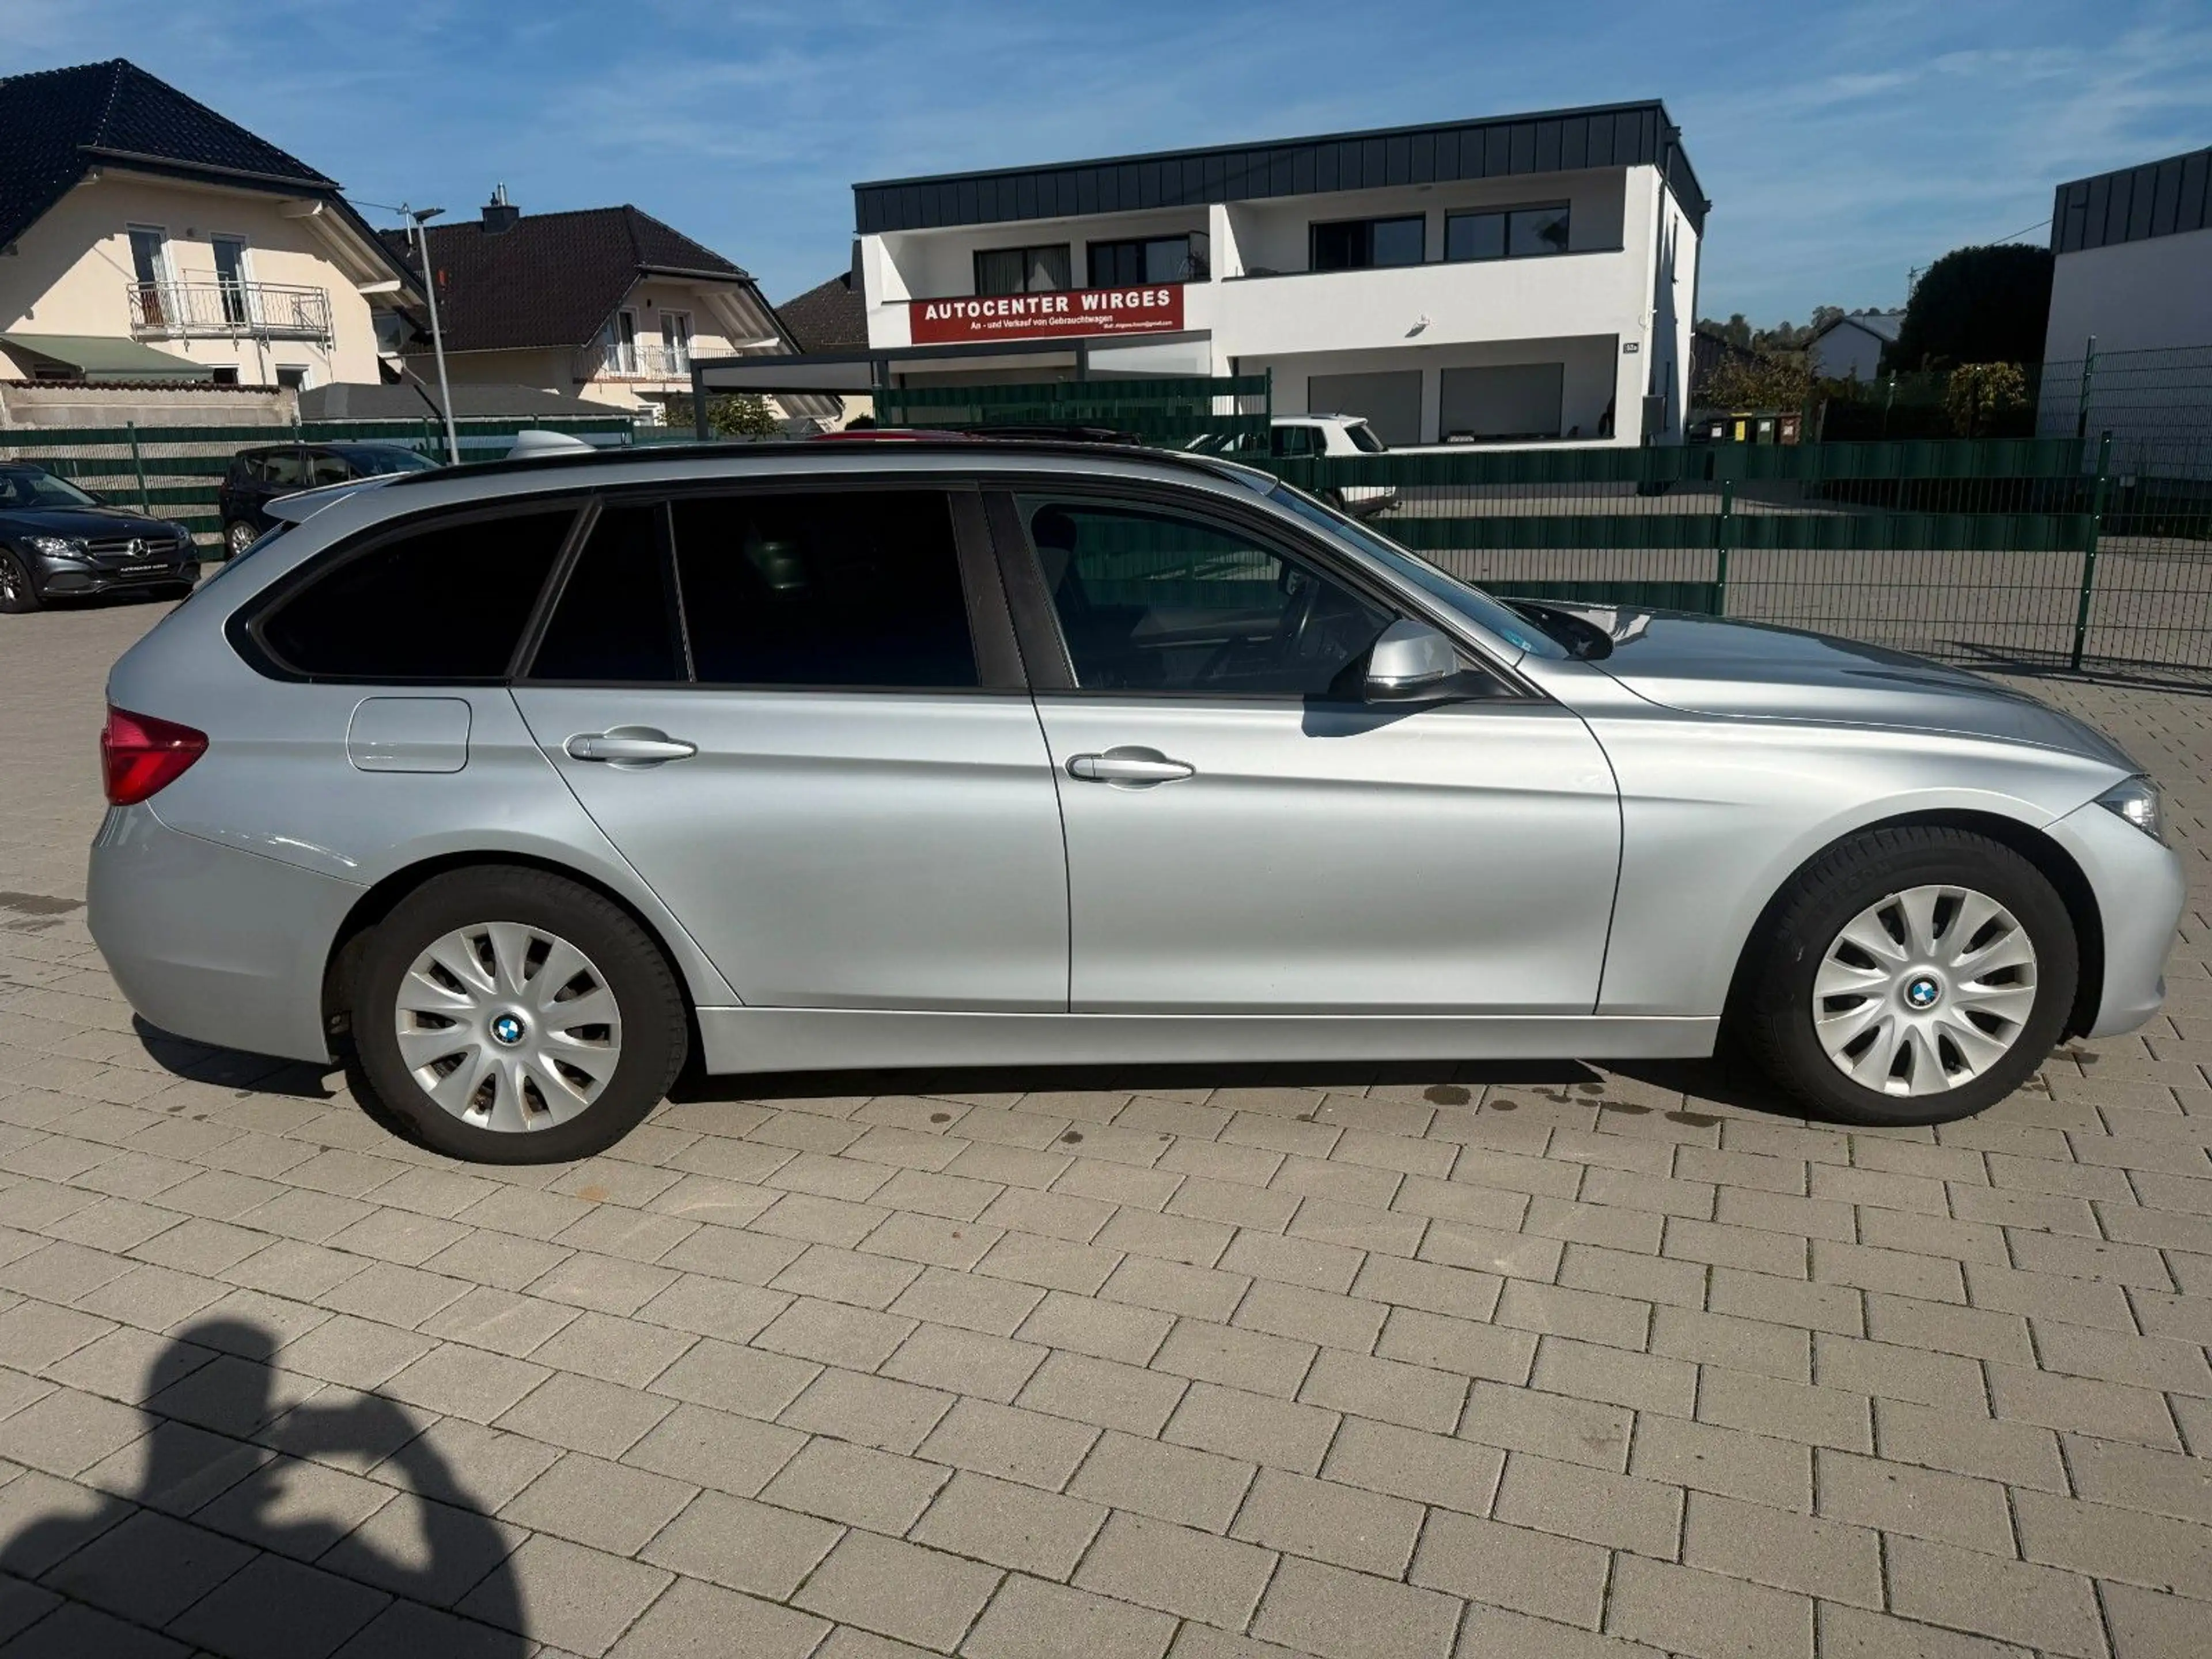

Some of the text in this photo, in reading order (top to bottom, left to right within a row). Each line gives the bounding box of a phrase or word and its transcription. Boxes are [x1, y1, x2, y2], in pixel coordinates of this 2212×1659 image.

[925, 289, 1171, 320] AUTOCENTER WIRGES
[970, 321, 981, 329] An
[987, 319, 1002, 329] und
[1002, 317, 1032, 328] Verkauf
[1032, 319, 1048, 327] von
[1048, 315, 1113, 325] Gebrauchtwagen
